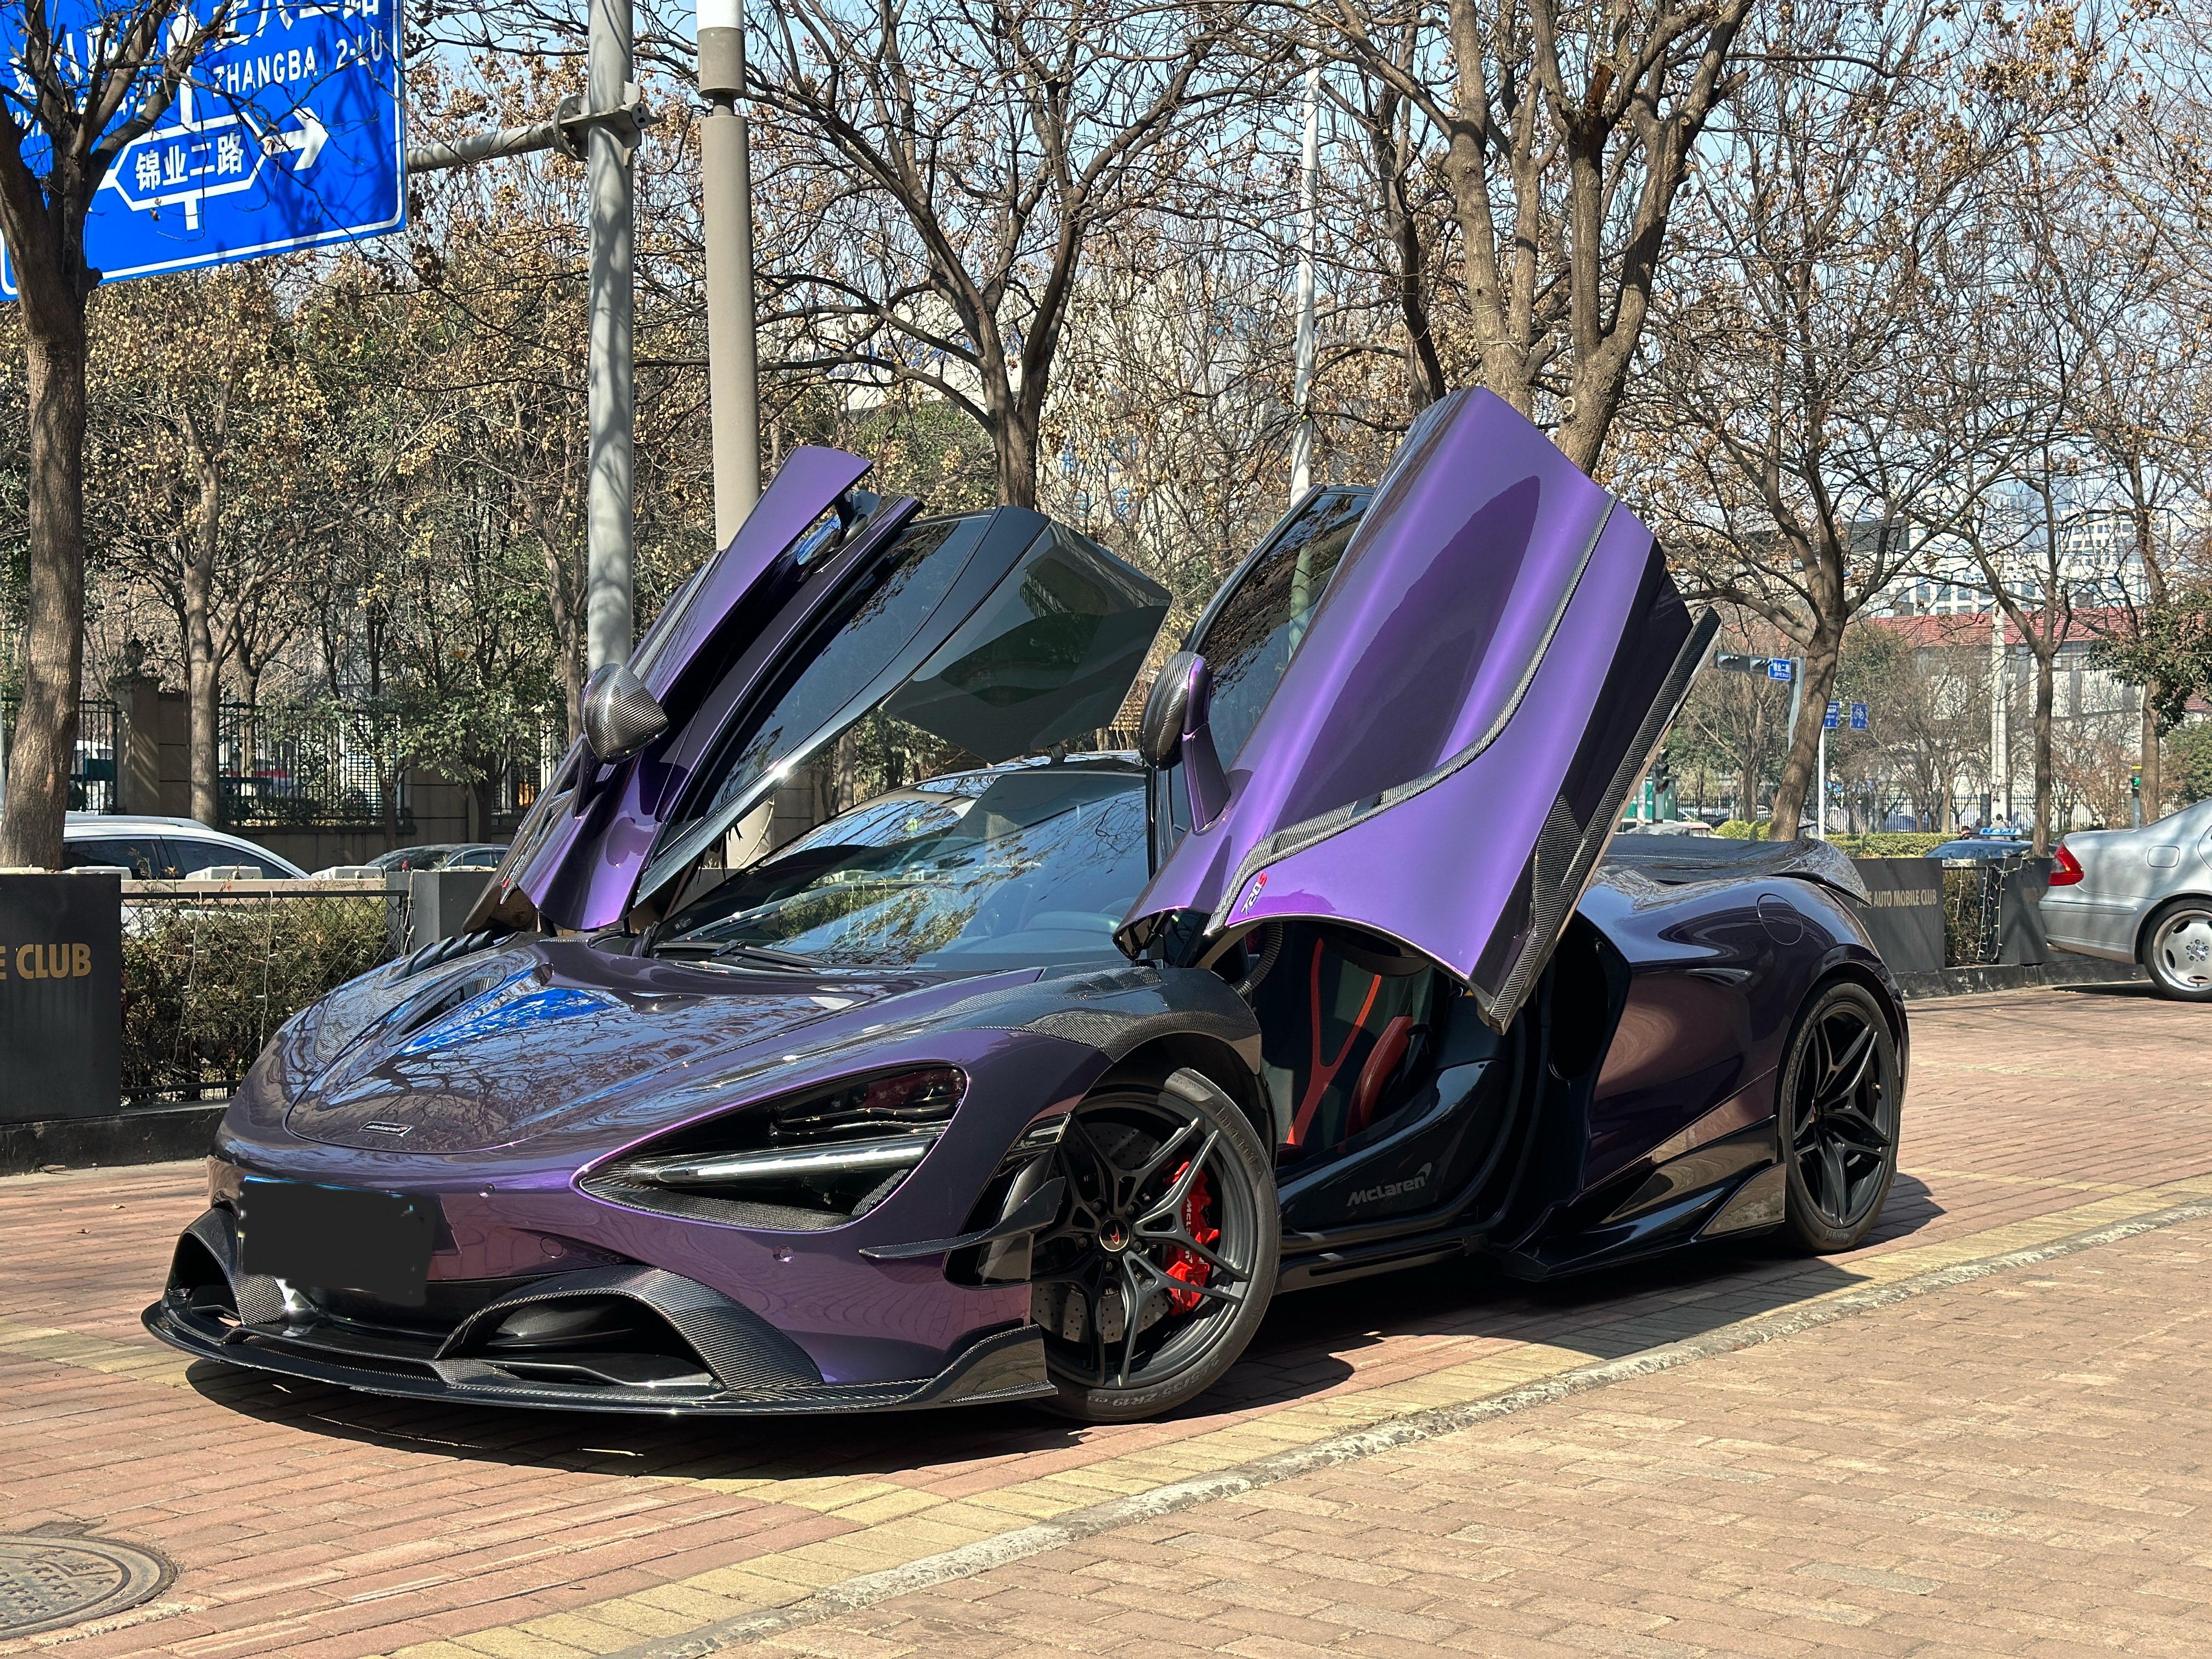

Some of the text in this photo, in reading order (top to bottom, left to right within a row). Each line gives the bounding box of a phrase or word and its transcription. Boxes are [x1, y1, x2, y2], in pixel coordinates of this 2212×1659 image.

[213, 47, 318, 97] ZHANGBA
[135, 132, 244, 191] 锦业二路
[1240, 871, 1268, 916] 720S
[1874, 890, 1892, 907] AUTO
[1893, 889, 1920, 907] MOBILE
[1921, 889, 1937, 906] CLUB
[16, 943, 92, 980] CLUB
[1346, 1176, 1426, 1207] McLaren
